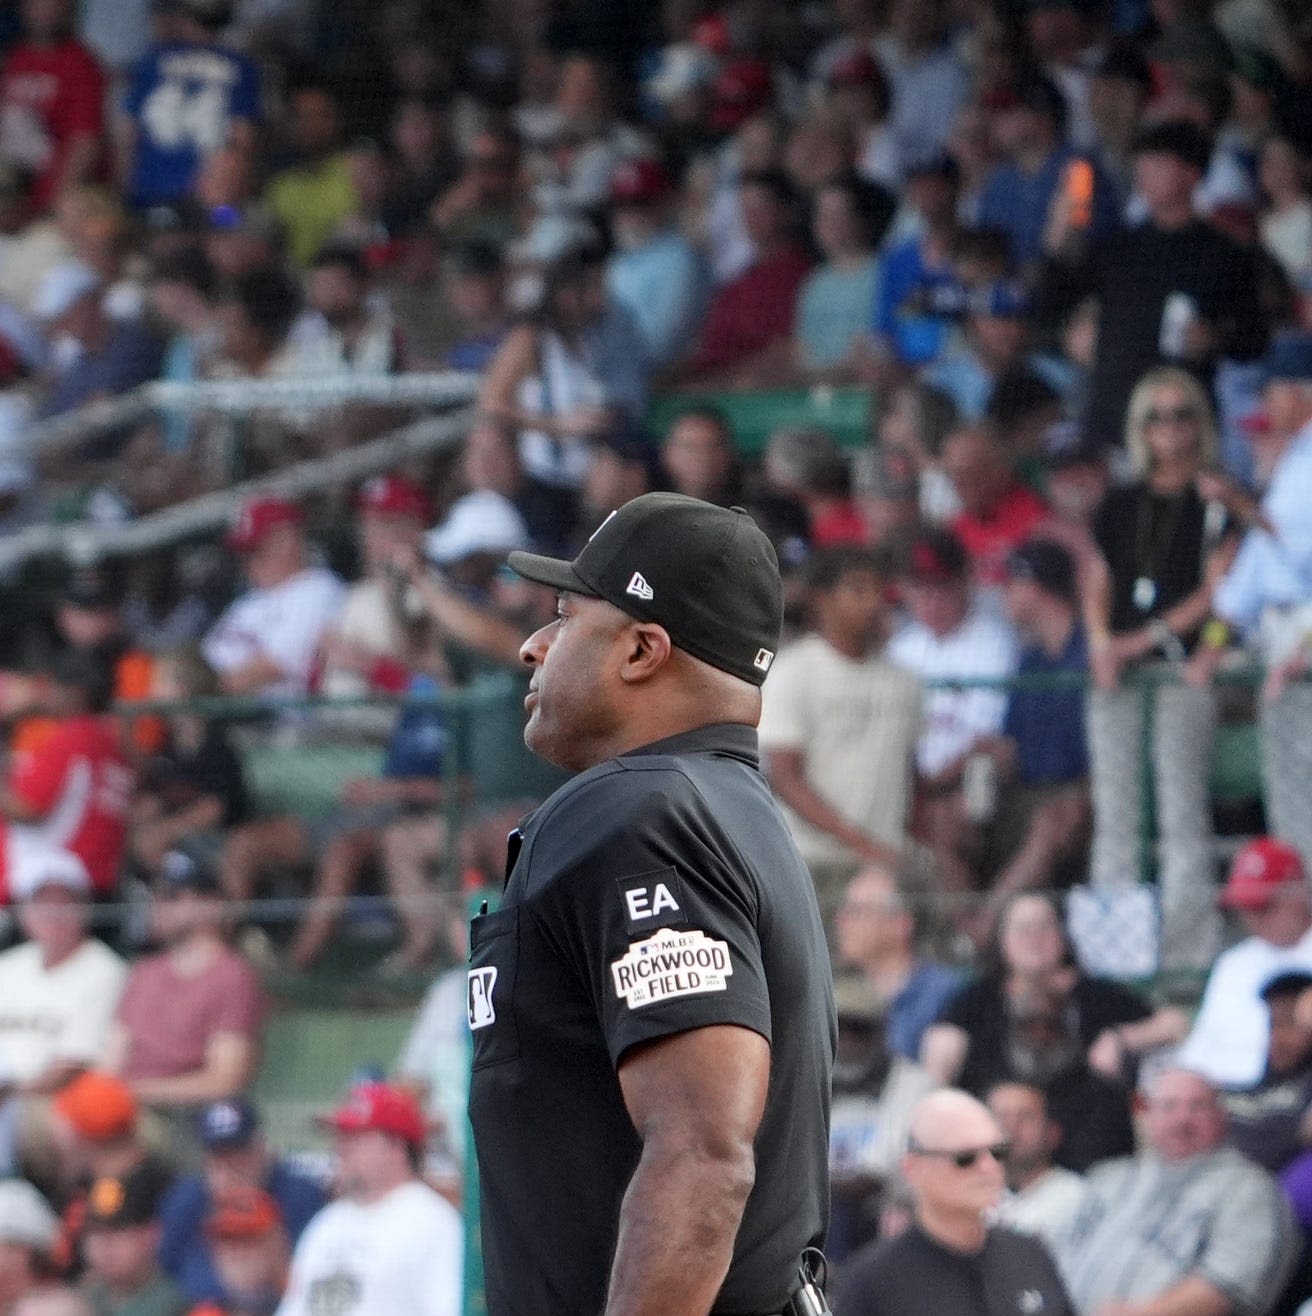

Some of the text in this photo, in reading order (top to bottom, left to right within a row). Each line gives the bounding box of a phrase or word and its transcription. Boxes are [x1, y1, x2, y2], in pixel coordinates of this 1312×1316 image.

[625, 883, 679, 920] EA
[661, 937, 688, 950] MLB
[617, 947, 725, 991] RICKWOOD
[648, 972, 701, 998] FIELD
